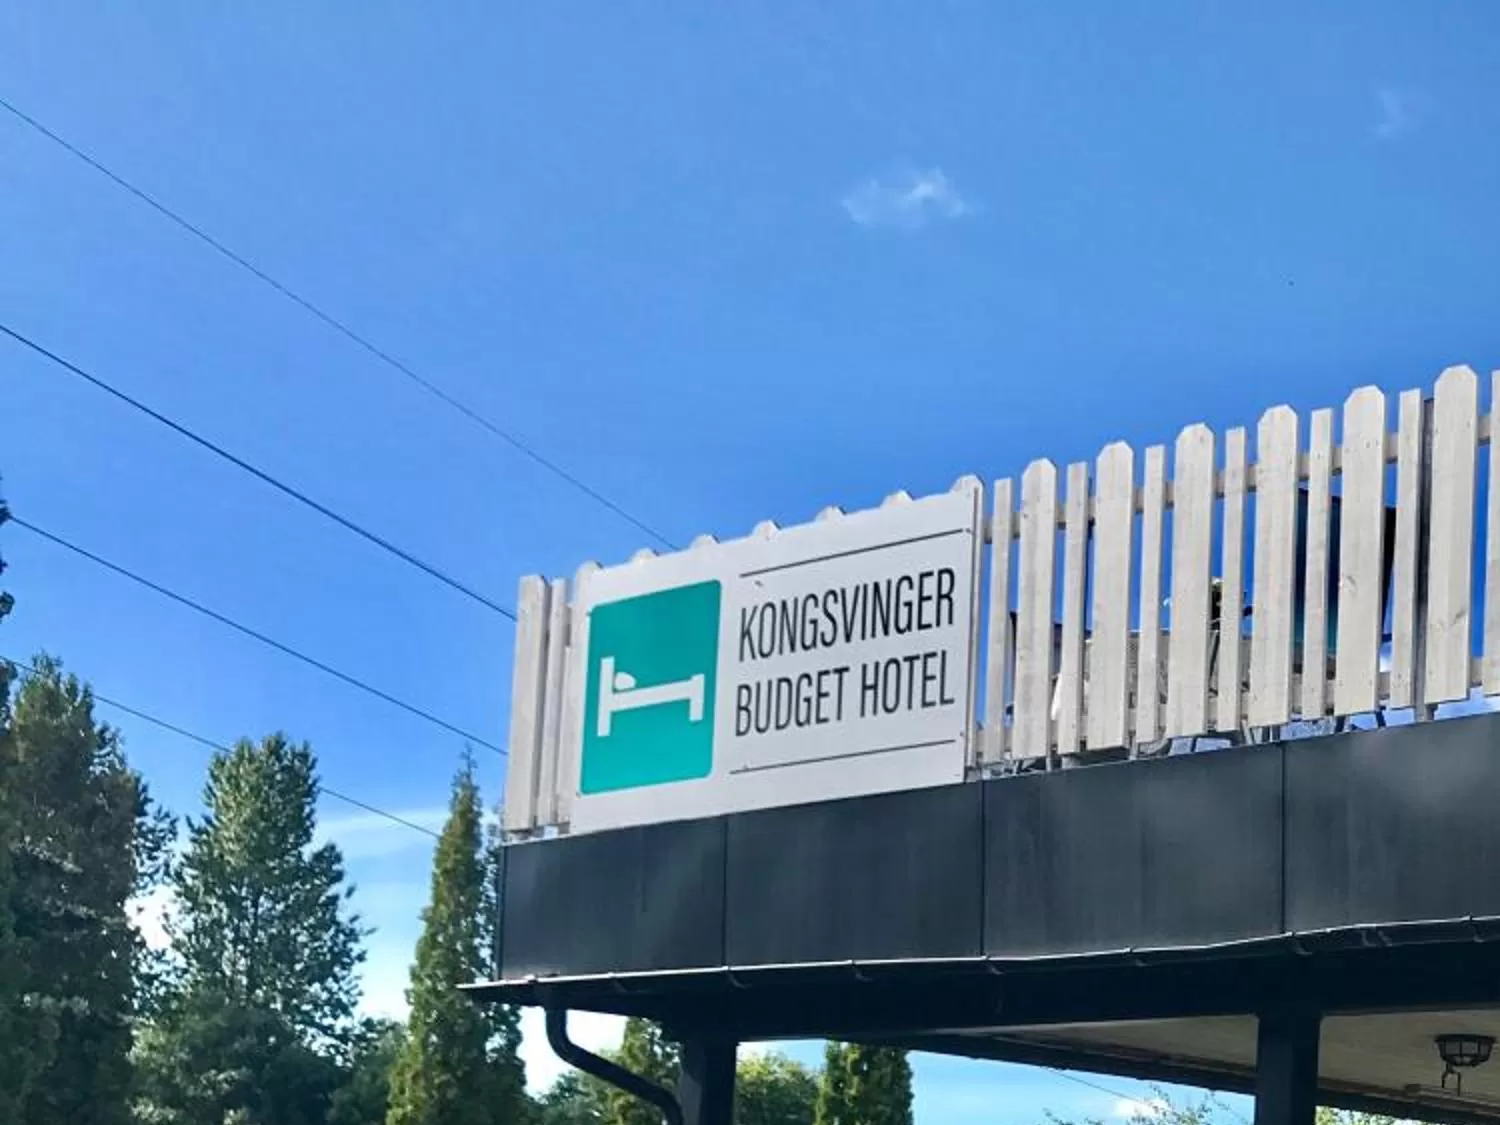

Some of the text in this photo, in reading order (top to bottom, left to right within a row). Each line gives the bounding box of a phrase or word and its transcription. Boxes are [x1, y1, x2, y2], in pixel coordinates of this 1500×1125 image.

[739, 567, 956, 662] KONGSVINGER
[735, 649, 955, 737] BUDGET HOTEL
